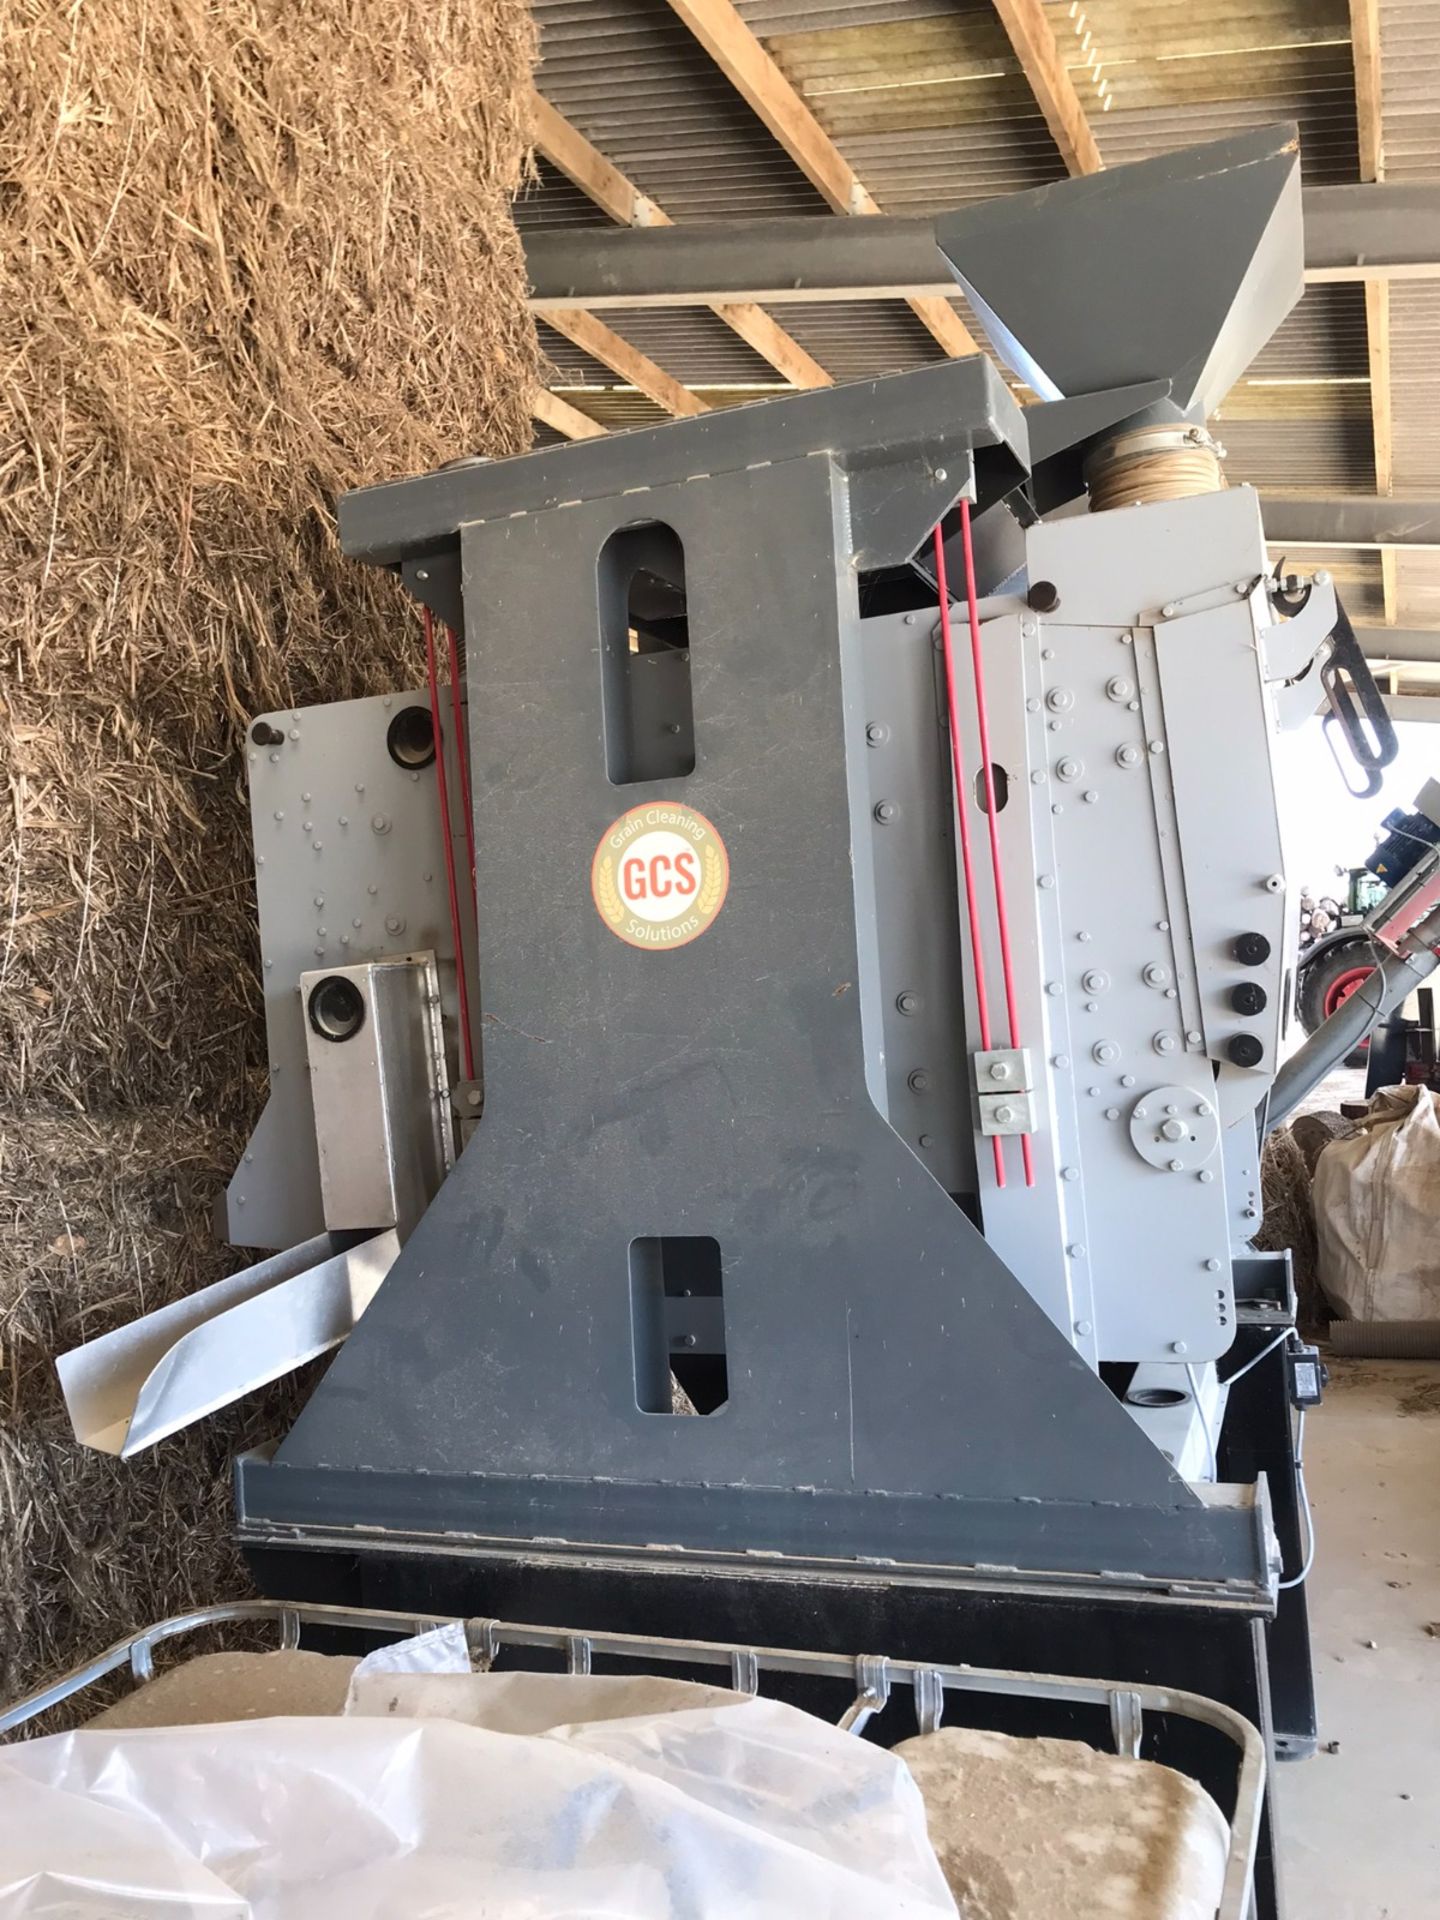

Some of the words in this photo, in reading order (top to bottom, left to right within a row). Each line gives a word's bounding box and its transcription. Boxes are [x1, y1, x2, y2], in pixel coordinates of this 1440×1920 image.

[610, 818, 644, 848] Grain
[646, 809, 706, 841] Cleaning
[623, 852, 697, 900] GCS
[626, 915, 699, 941] Solutions
